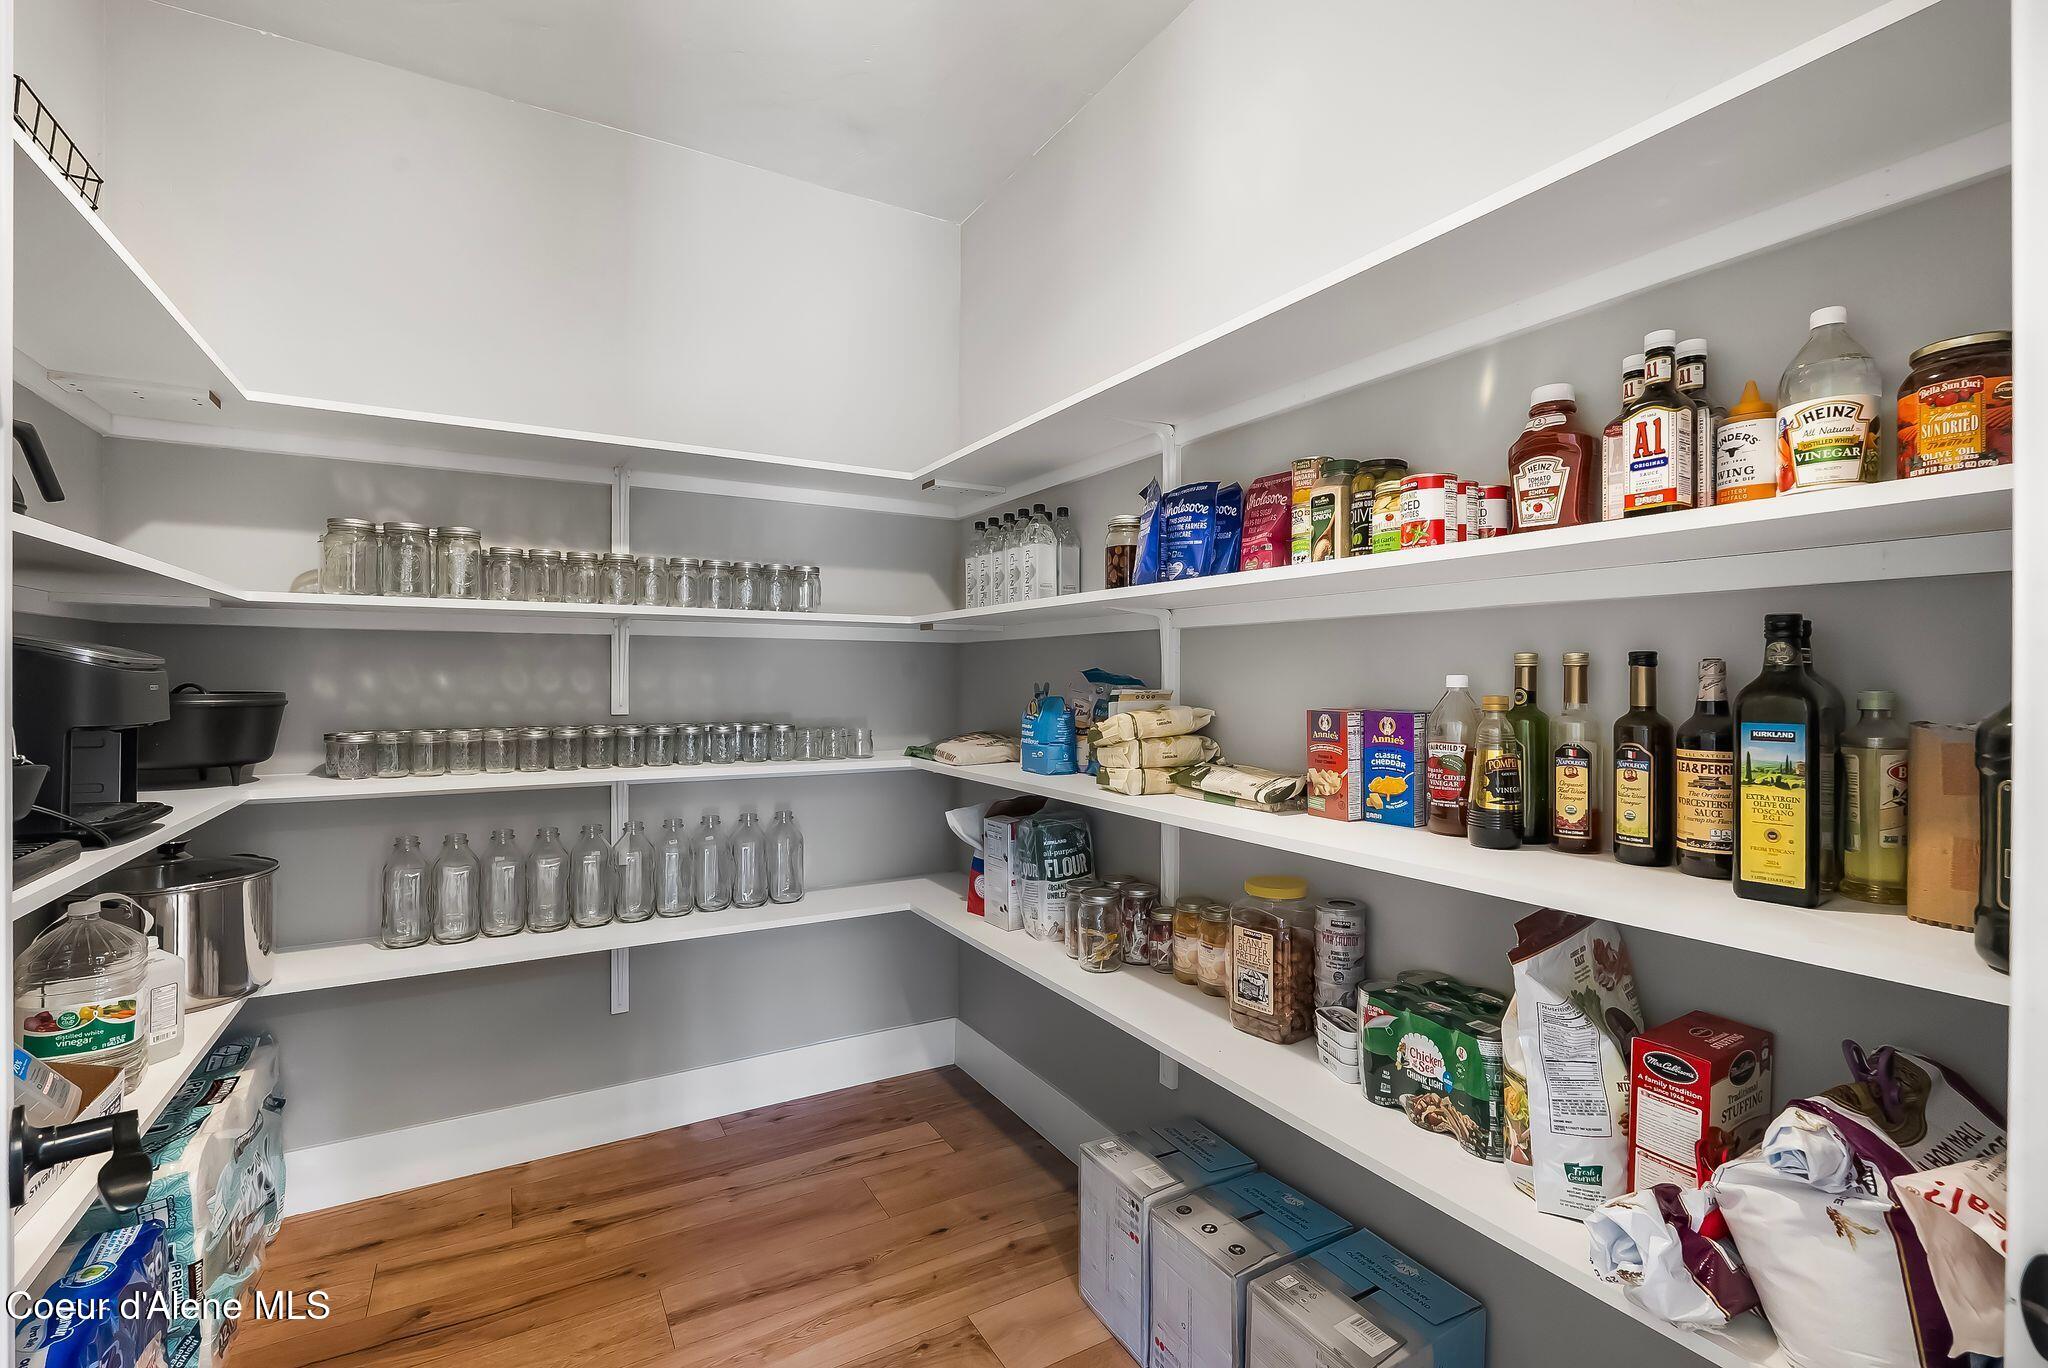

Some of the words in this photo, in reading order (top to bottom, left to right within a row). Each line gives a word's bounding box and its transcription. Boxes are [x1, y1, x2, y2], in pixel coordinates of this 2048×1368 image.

[1646, 361, 1659, 380] A1
[1679, 367, 1692, 385] A1
[1624, 382, 1635, 399] A1
[1919, 387, 1940, 399] Bella
[1941, 382, 1960, 392] Sun
[1961, 379, 1981, 388] Luci
[1803, 406, 1856, 424] HEINZ
[1803, 428, 1816, 438] All
[1819, 424, 1855, 436] Natural
[1921, 423, 1941, 439] SUN
[1942, 415, 1979, 434] DRIED
[1633, 417, 1665, 459] A1
[1803, 439, 1833, 450] DISTILLED
[1795, 447, 1861, 462] VINEGAR
[1921, 450, 1952, 461] OLIVE
[1528, 463, 1551, 473] HEINZ
[1634, 460, 1665, 469] ORIGINAL
[1717, 465, 1755, 480] WING
[1528, 475, 1551, 483] TOMATO
[1529, 488, 1549, 496] SIMPLY
[1313, 513, 1332, 521] ONION
[1185, 522, 1208, 530] FARMERS
[1313, 730, 1338, 740] Annie's
[1372, 735, 1404, 745] Annie's
[1753, 730, 1794, 739] KIRKLAND
[1488, 758, 1517, 769] POMPEI
[1557, 759, 1587, 767] NAPOLEON
[1617, 760, 1648, 769] NAPOLEON
[1678, 762, 1690, 772] LEA
[1691, 763, 1699, 774] &
[1701, 764, 1732, 775] PERRI
[1430, 779, 1460, 788] VINEGAR
[1559, 780, 1584, 788] Organic
[1701, 792, 1731, 800] Original
[1746, 793, 1770, 801] EXTRA
[1772, 795, 1800, 804] VIRGIN
[1753, 801, 1777, 809] OLIVE
[1694, 809, 1724, 818] SAUCE
[1752, 807, 1794, 817] TOSCANO
[1044, 853, 1088, 878] FLOUR
[1047, 891, 1066, 899] UNBLEA
[1238, 936, 1268, 947] PEANUT
[1239, 943, 1268, 957] BUTTER
[1236, 950, 1271, 966] PRETZELS
[55, 1032, 83, 1041] distilled
[83, 1029, 104, 1038] white
[55, 1037, 94, 1048] vinegar
[1409, 1047, 1442, 1068] Chicken
[1419, 1061, 1435, 1074] Sea
[1406, 1069, 1428, 1085] CHUNK
[1428, 1076, 1443, 1091] LIGHT
[1617, 1082, 1630, 1092] NU
[1645, 1075, 1667, 1089] family
[1669, 1083, 1702, 1101] tradition
[1653, 1086, 1670, 1097] since
[1670, 1092, 1684, 1101] 1948
[1728, 1081, 1759, 1105] Traditional
[1721, 1091, 1763, 1123] STUFFING
[1947, 1121, 1986, 1153] MALI
[1572, 1166, 1595, 1176] Fresh
[1567, 1173, 1600, 1183] Gourmet
[1355, 1251, 1375, 1265] FROM
[1374, 1263, 1388, 1274] THE
[1388, 1271, 1432, 1302] LEGENDARY
[1399, 1286, 1431, 1310] ICELAND
